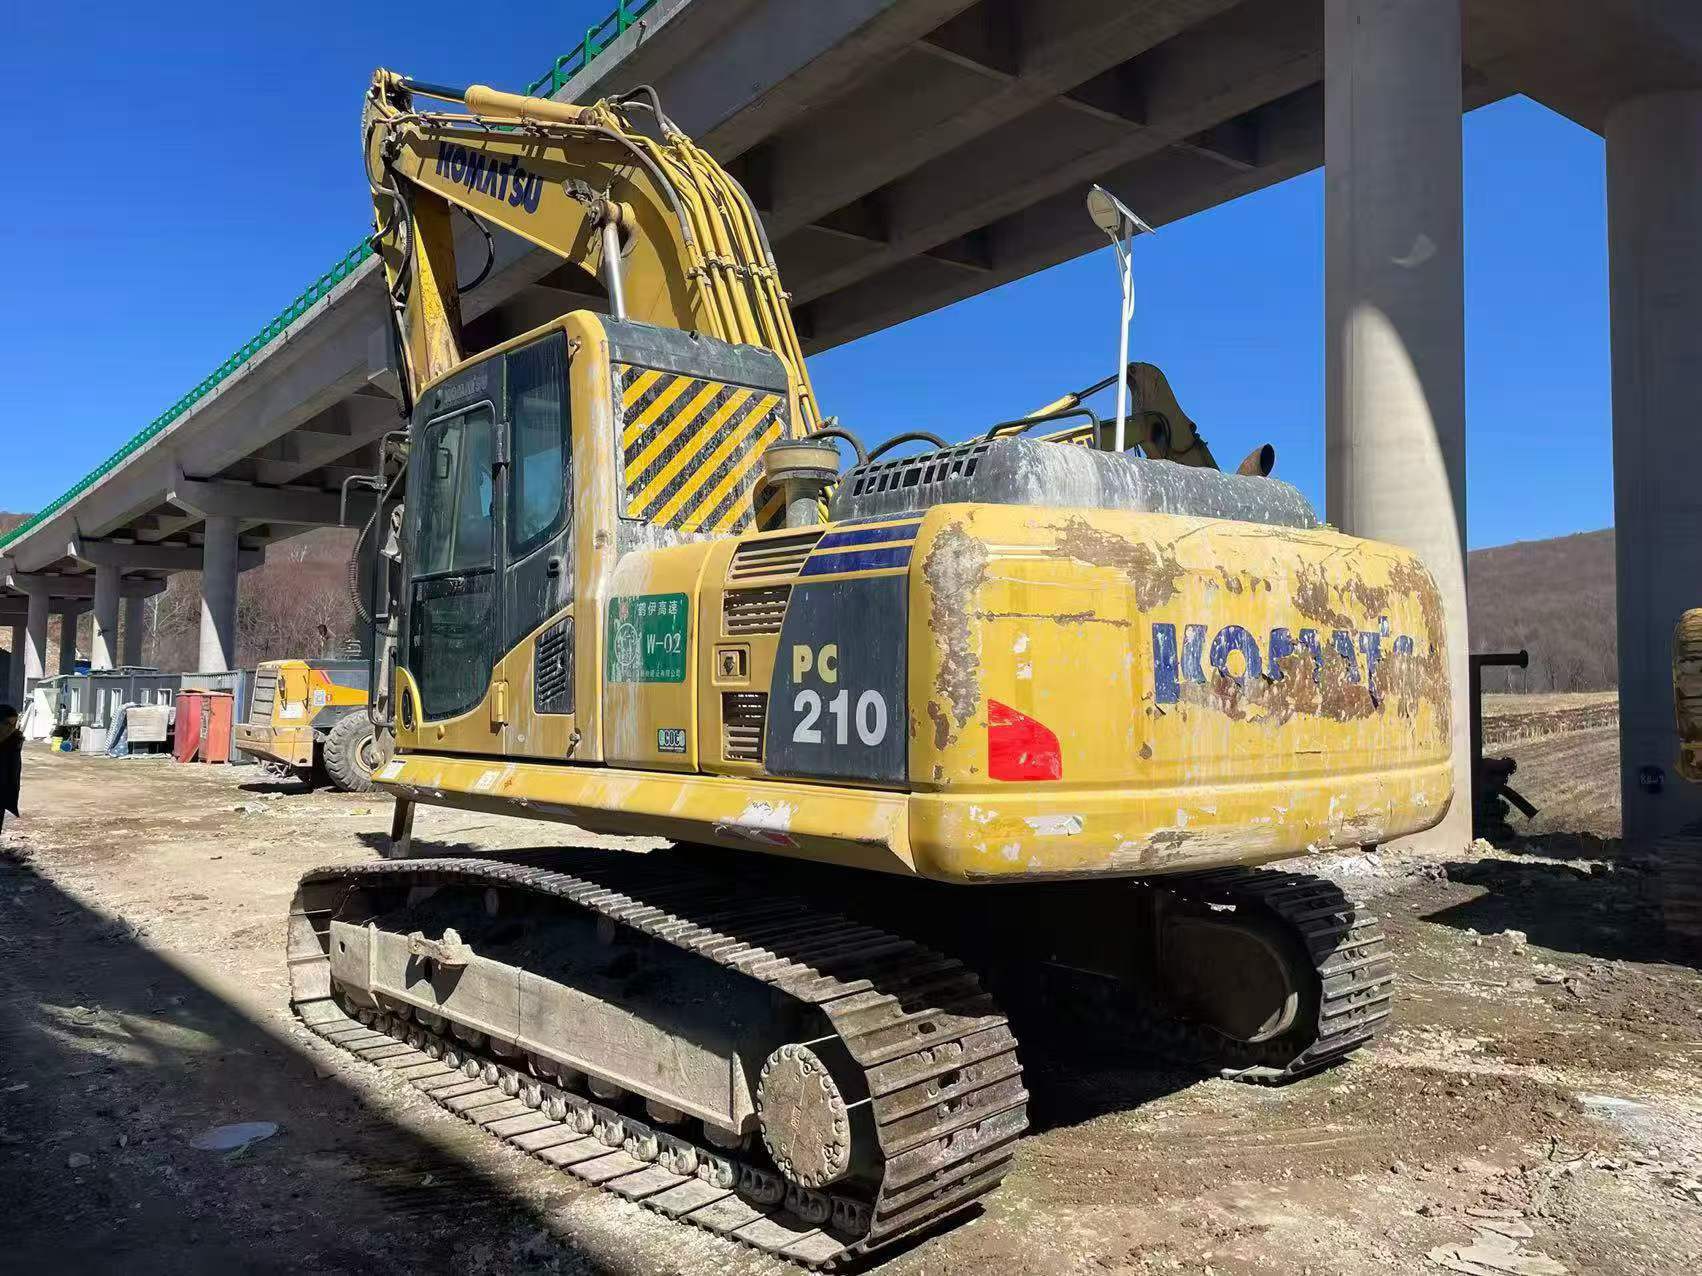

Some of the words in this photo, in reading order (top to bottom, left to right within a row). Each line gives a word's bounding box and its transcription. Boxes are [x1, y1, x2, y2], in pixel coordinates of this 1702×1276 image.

[435, 141, 544, 214] KOMATSU
[647, 633, 681, 654] W-02
[792, 643, 837, 683] PC
[792, 689, 888, 746] 210
